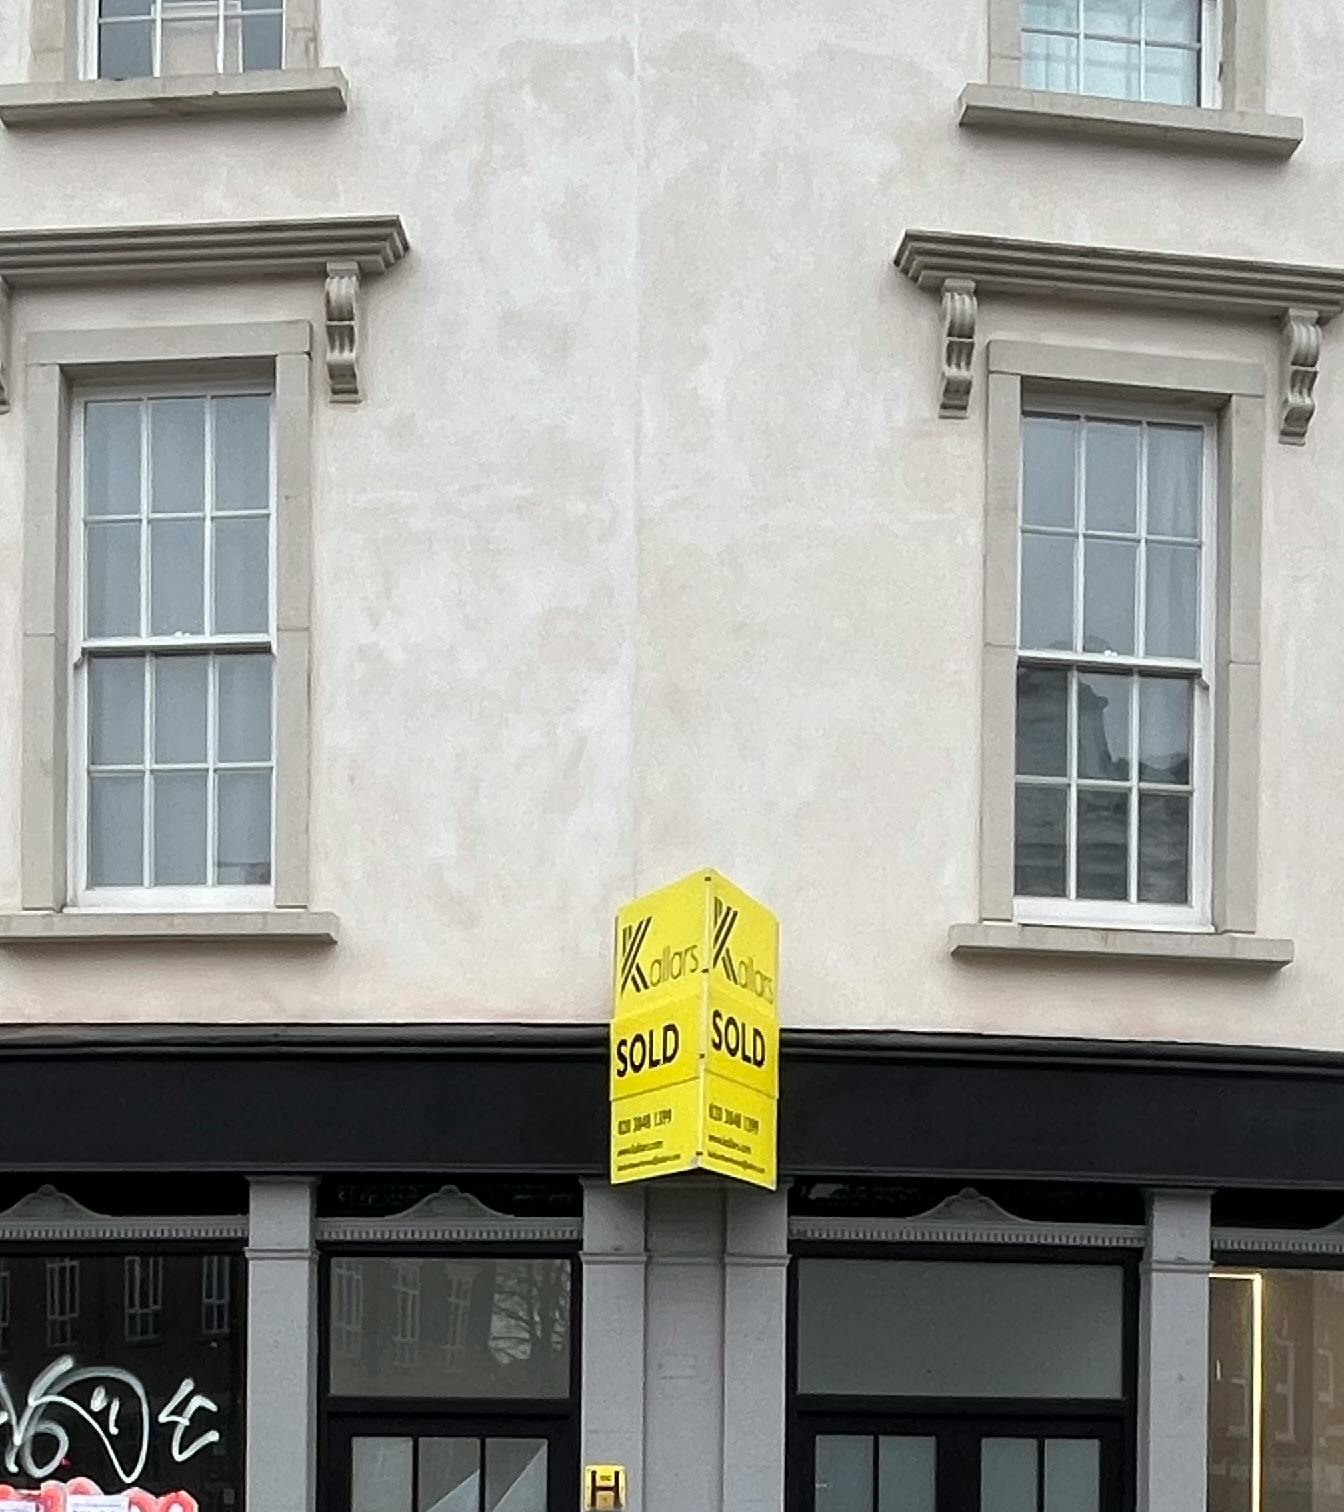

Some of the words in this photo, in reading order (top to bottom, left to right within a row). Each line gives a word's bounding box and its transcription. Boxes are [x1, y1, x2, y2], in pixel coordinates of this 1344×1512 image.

[616, 1023, 680, 1078] SOLD
[712, 1008, 766, 1069] SOLD
[591, 1470, 620, 1507] H
